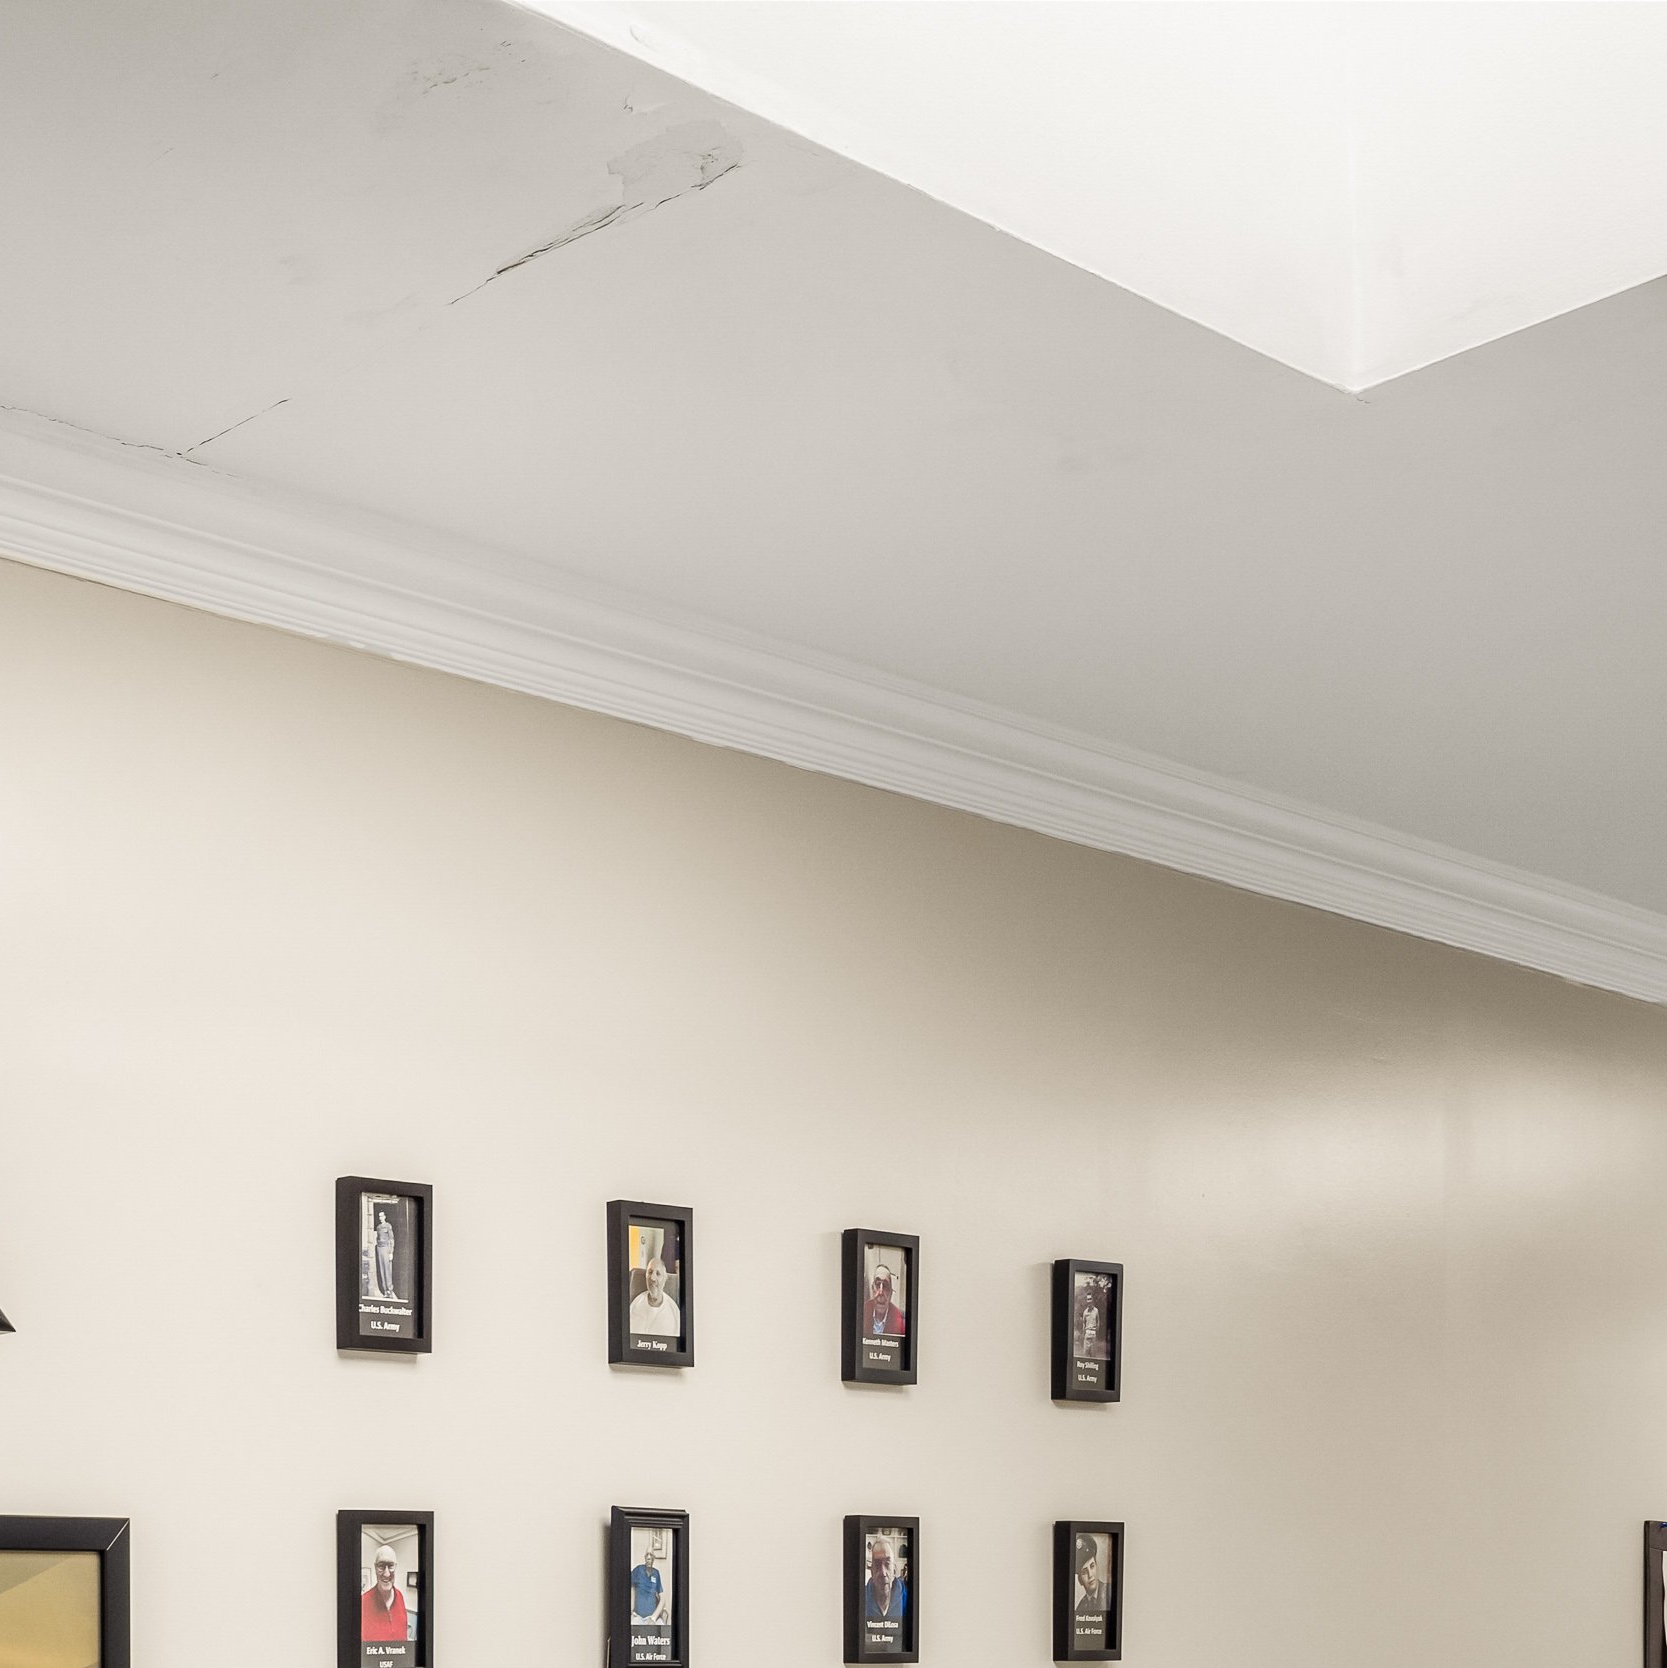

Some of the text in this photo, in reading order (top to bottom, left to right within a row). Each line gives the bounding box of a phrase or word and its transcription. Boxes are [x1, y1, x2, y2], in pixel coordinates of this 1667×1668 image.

[370, 1320, 401, 1333] U.S. Army
[637, 1339, 652, 1350] Jerry
[869, 1352, 892, 1362] U.S. Army
[631, 1635, 670, 1647] John Waters
[881, 1635, 893, 1643] Army
